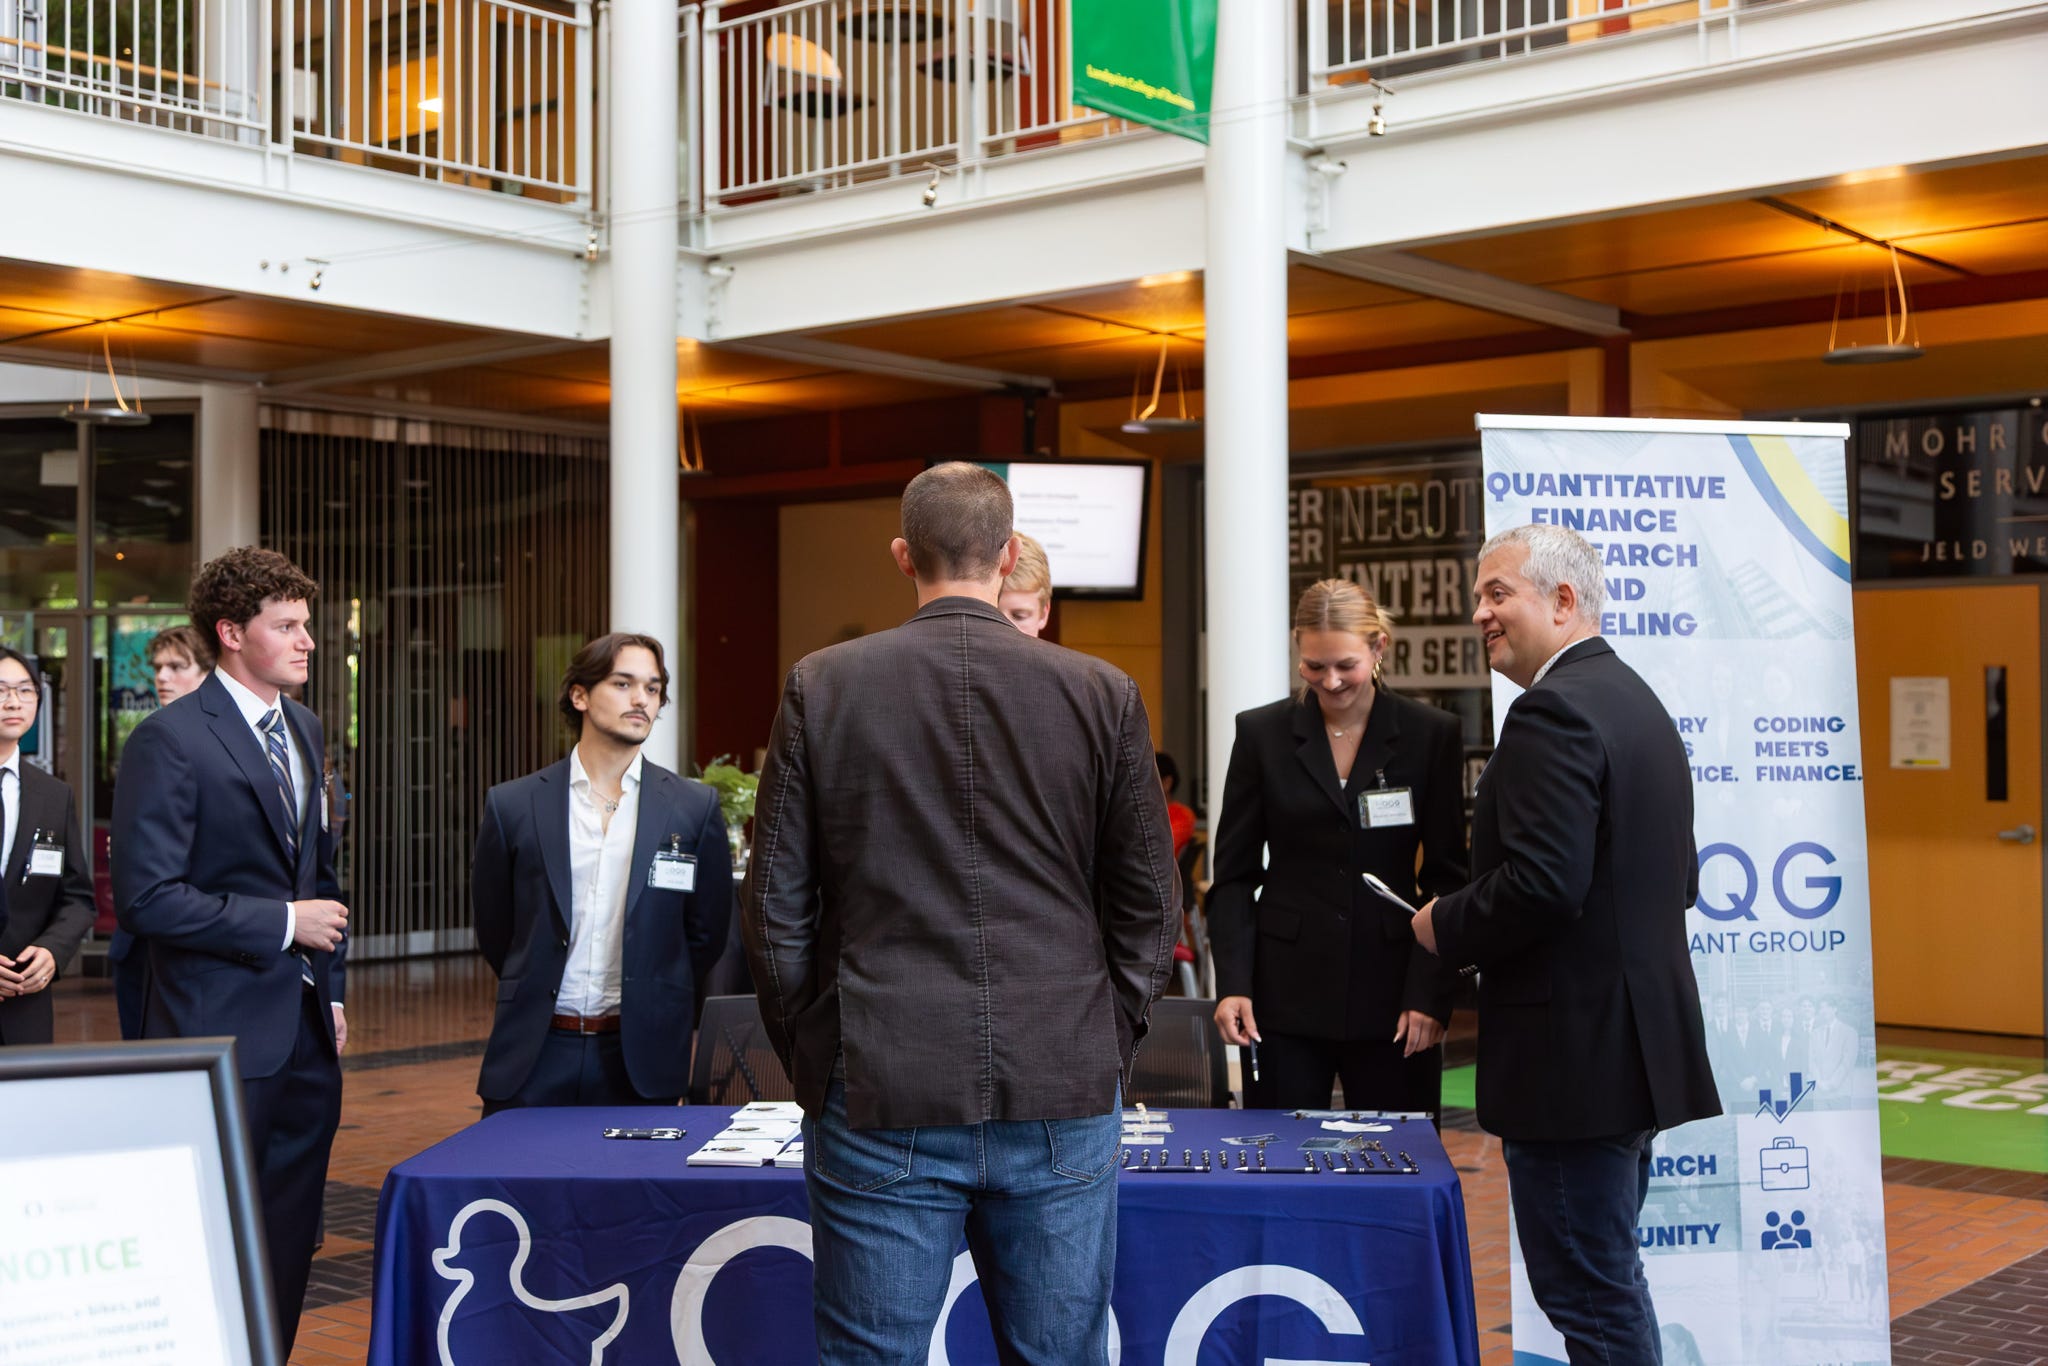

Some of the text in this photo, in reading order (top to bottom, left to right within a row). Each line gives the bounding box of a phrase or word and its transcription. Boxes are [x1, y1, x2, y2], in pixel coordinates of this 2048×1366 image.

[1885, 424, 2007, 459] MOHR
[1487, 472, 1726, 501] QUANTITATIVE
[1939, 465, 2046, 500] SERV
[1340, 479, 1484, 544] NEGOT
[1532, 508, 1677, 532] FINANCE
[1921, 540, 1988, 562] JELD
[1605, 578, 1646, 600] ND
[1600, 613, 1698, 636] ELING
[1754, 716, 1845, 733] CODING
[1755, 741, 1829, 757] MEETS
[1756, 765, 1863, 781] FINANCE.
[1696, 842, 1842, 921] QG
[1690, 930, 1845, 954] ANT GROUP
[1636, 1223, 1721, 1248] UNITY
[0, 1235, 143, 1285] NOTICE
